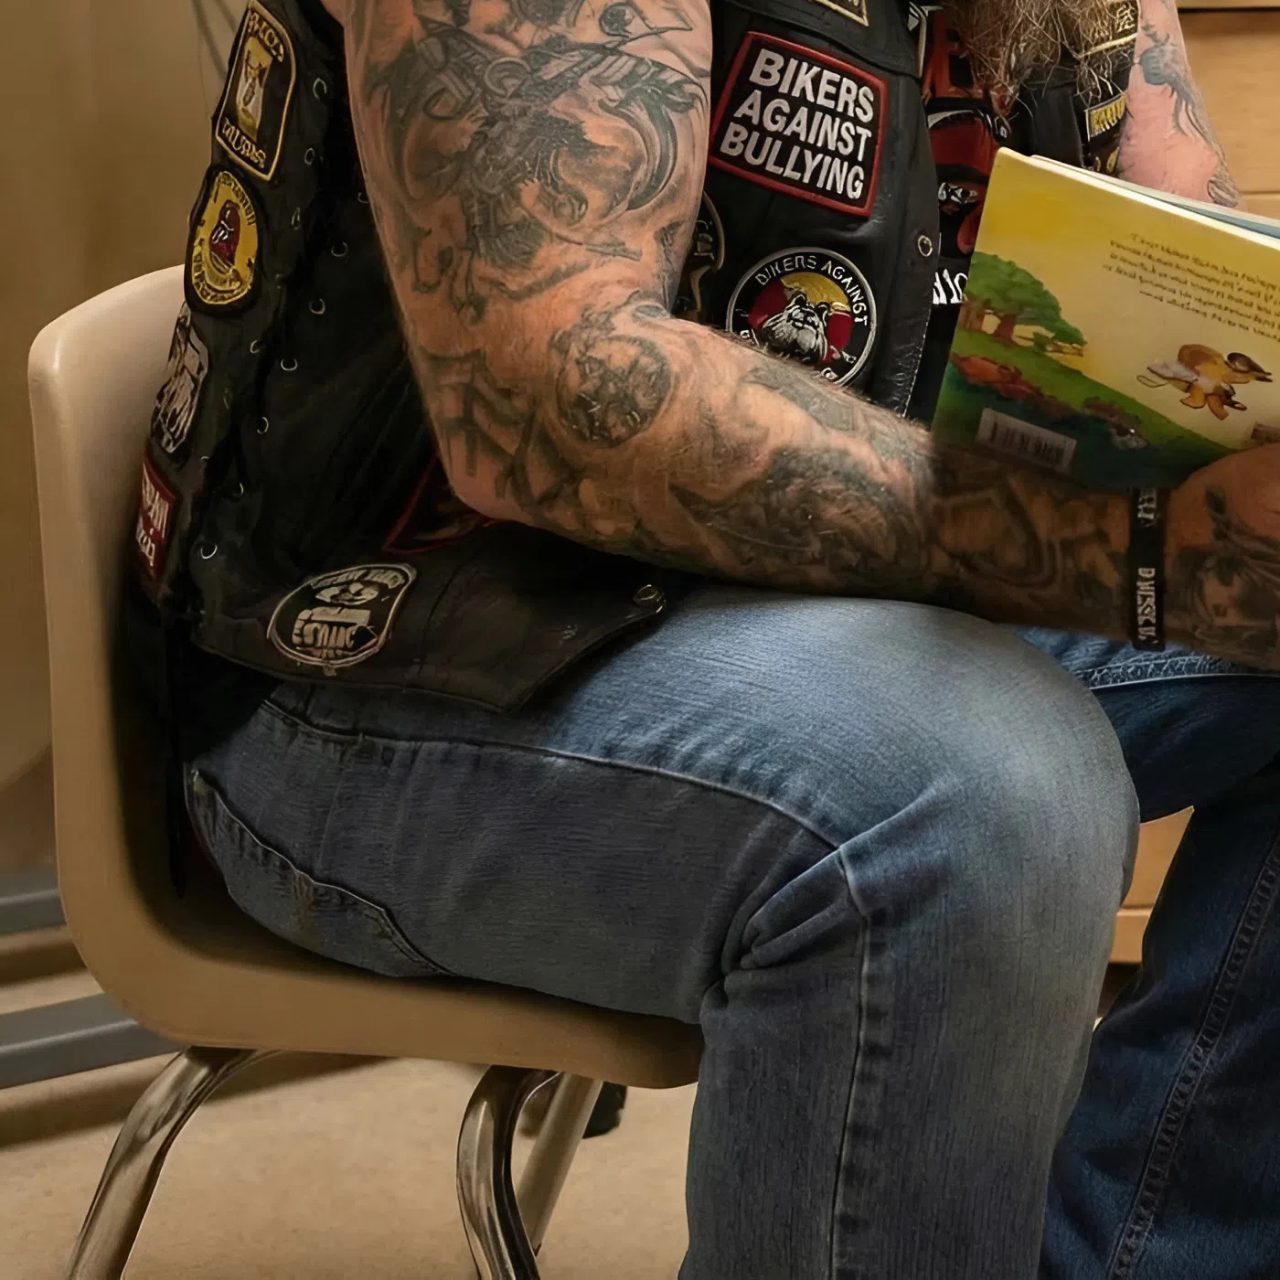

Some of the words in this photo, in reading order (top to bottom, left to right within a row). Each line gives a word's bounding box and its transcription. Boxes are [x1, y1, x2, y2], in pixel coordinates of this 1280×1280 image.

[749, 49, 874, 123] BIKERS
[720, 122, 864, 199] BULLYING
[734, 90, 872, 161] AGAINST
